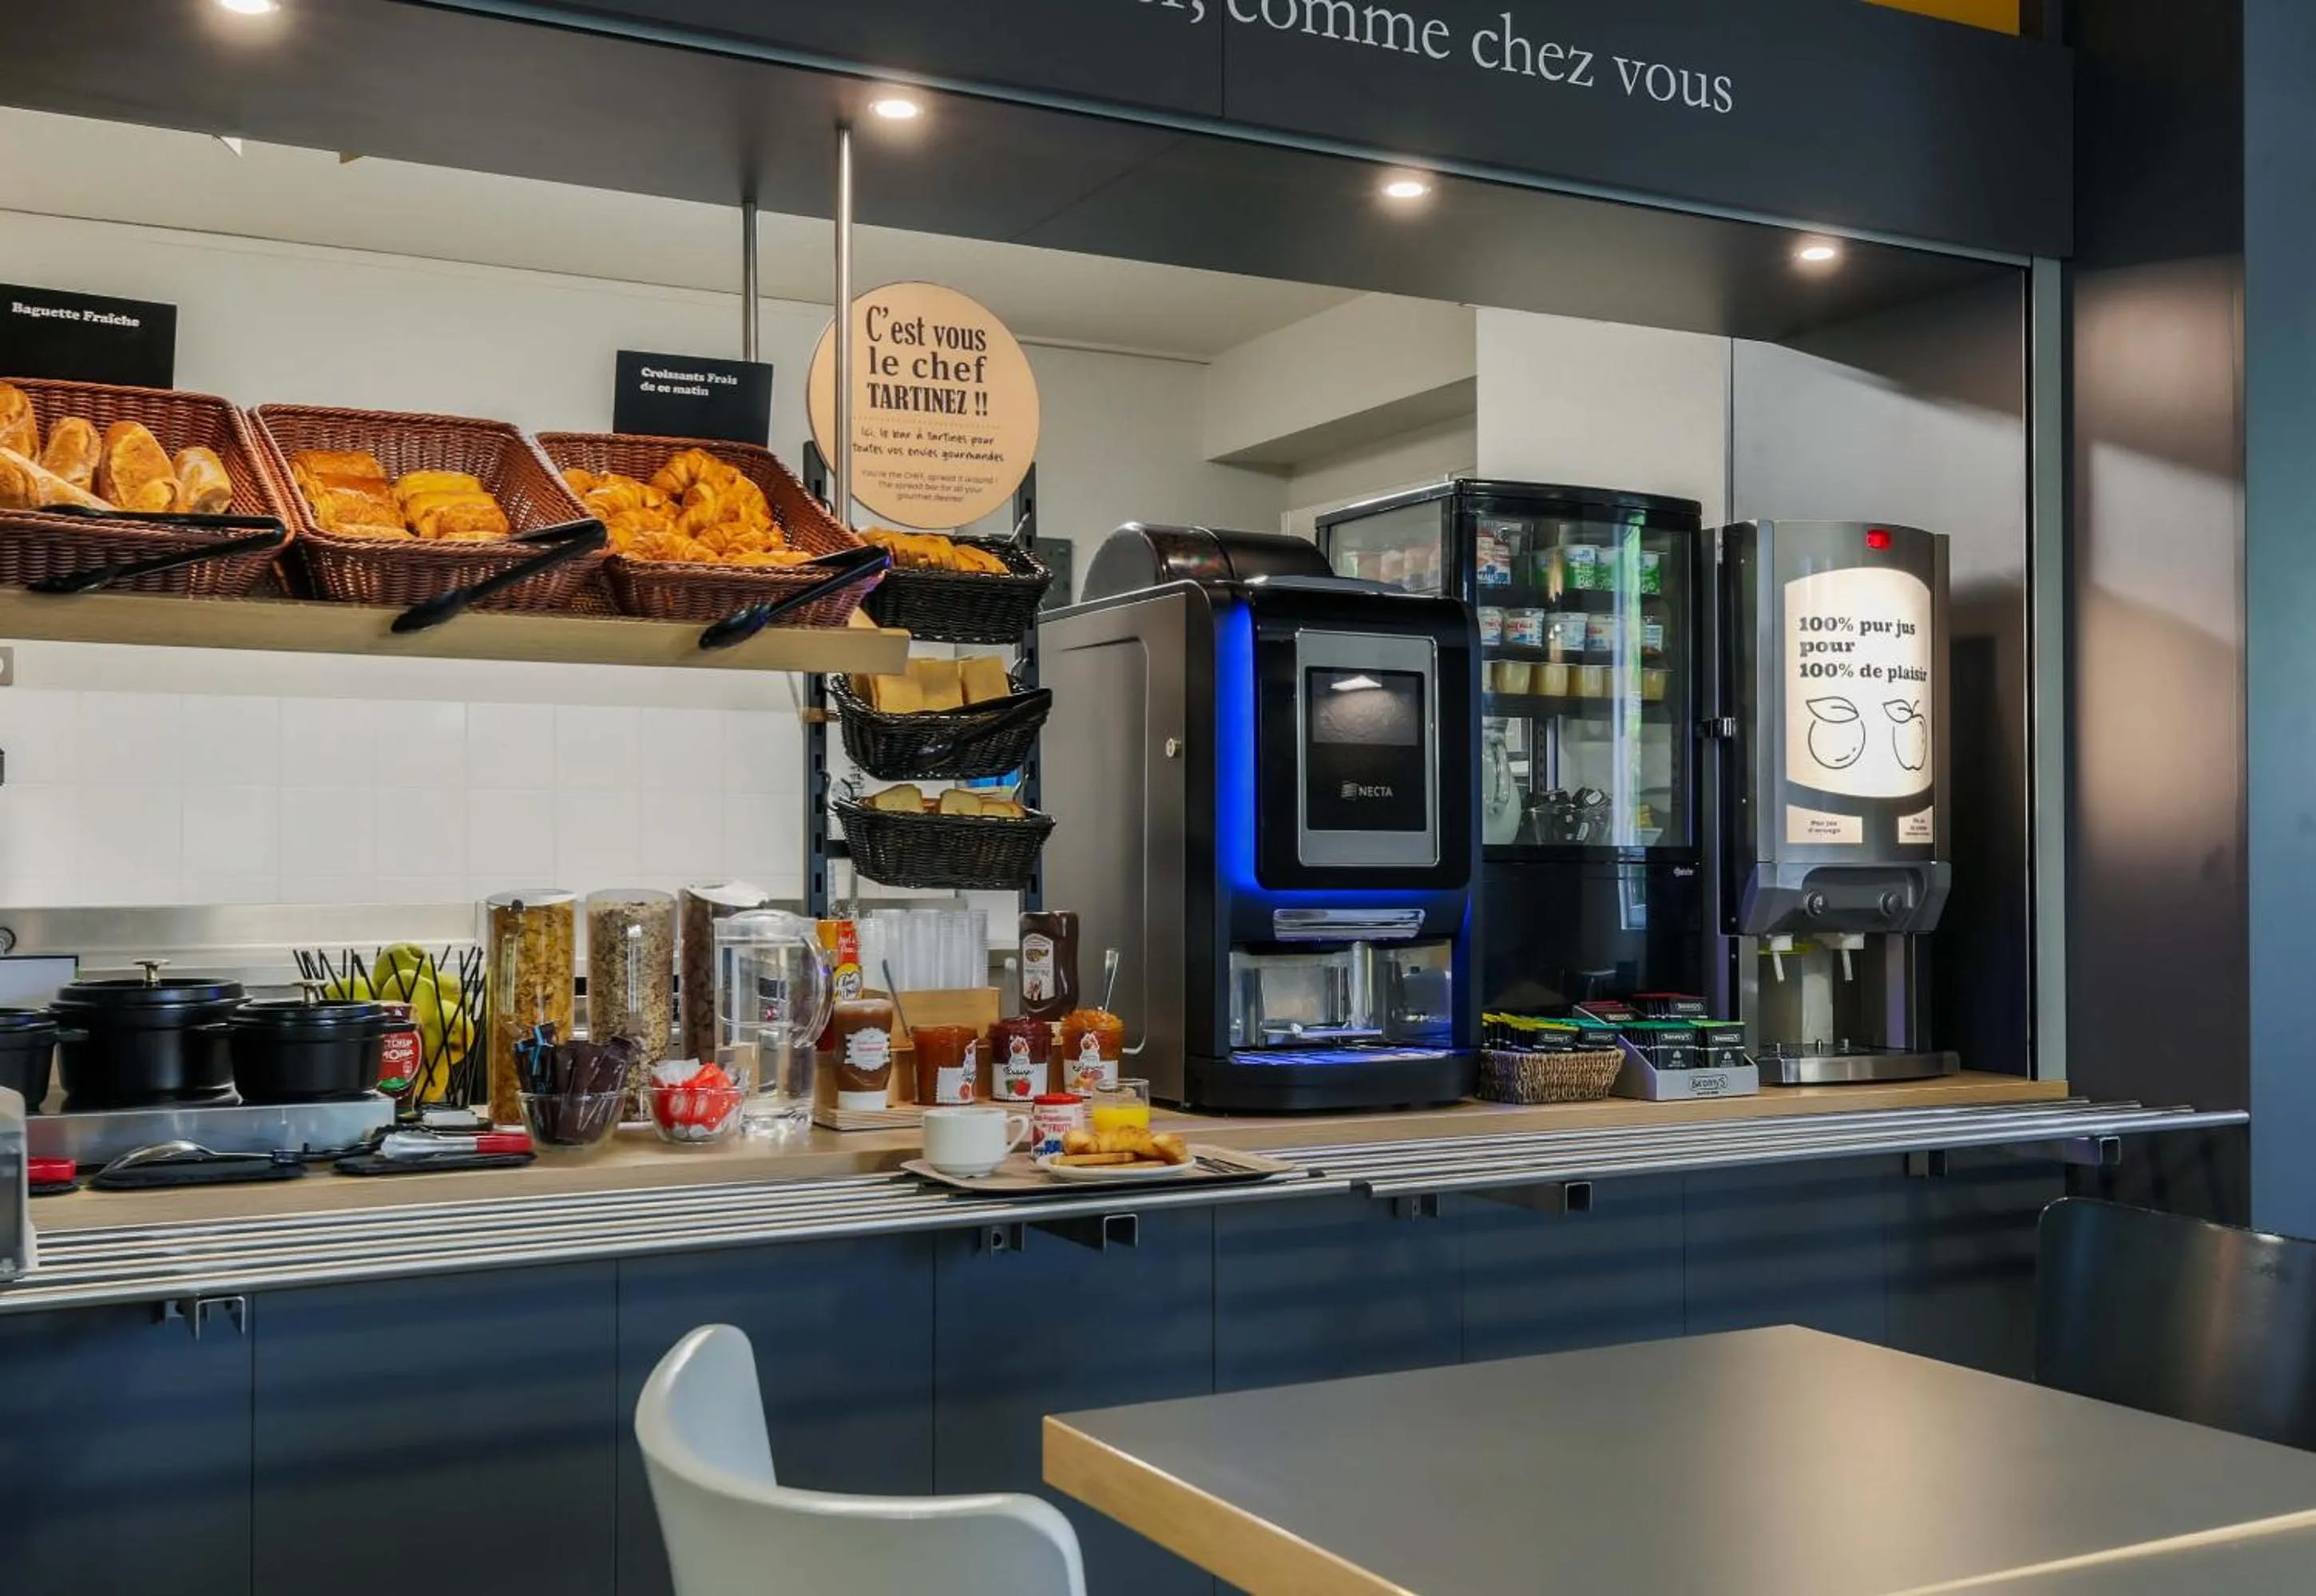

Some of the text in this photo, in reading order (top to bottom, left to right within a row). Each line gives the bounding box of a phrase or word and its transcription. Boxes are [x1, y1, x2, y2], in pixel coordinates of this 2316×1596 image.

[1227, 0, 1733, 113] comme chez vous
[11, 301, 81, 320] Baguette
[865, 305, 987, 352] C'est vous
[869, 346, 988, 384] le chef
[640, 366, 738, 386] Croissants Frais
[640, 381, 655, 392] de
[672, 386, 709, 396] matin
[867, 382, 968, 415] TARTINEZ
[852, 442, 883, 455] toutes
[907, 447, 938, 458] envies
[942, 449, 1004, 462] gourmandes
[970, 437, 994, 447] pour
[1798, 616, 1916, 638] 100% pur jus
[1799, 640, 1856, 658] pour
[1799, 663, 1928, 683] 100% de plaisir
[1359, 785, 1394, 798] NECTA
